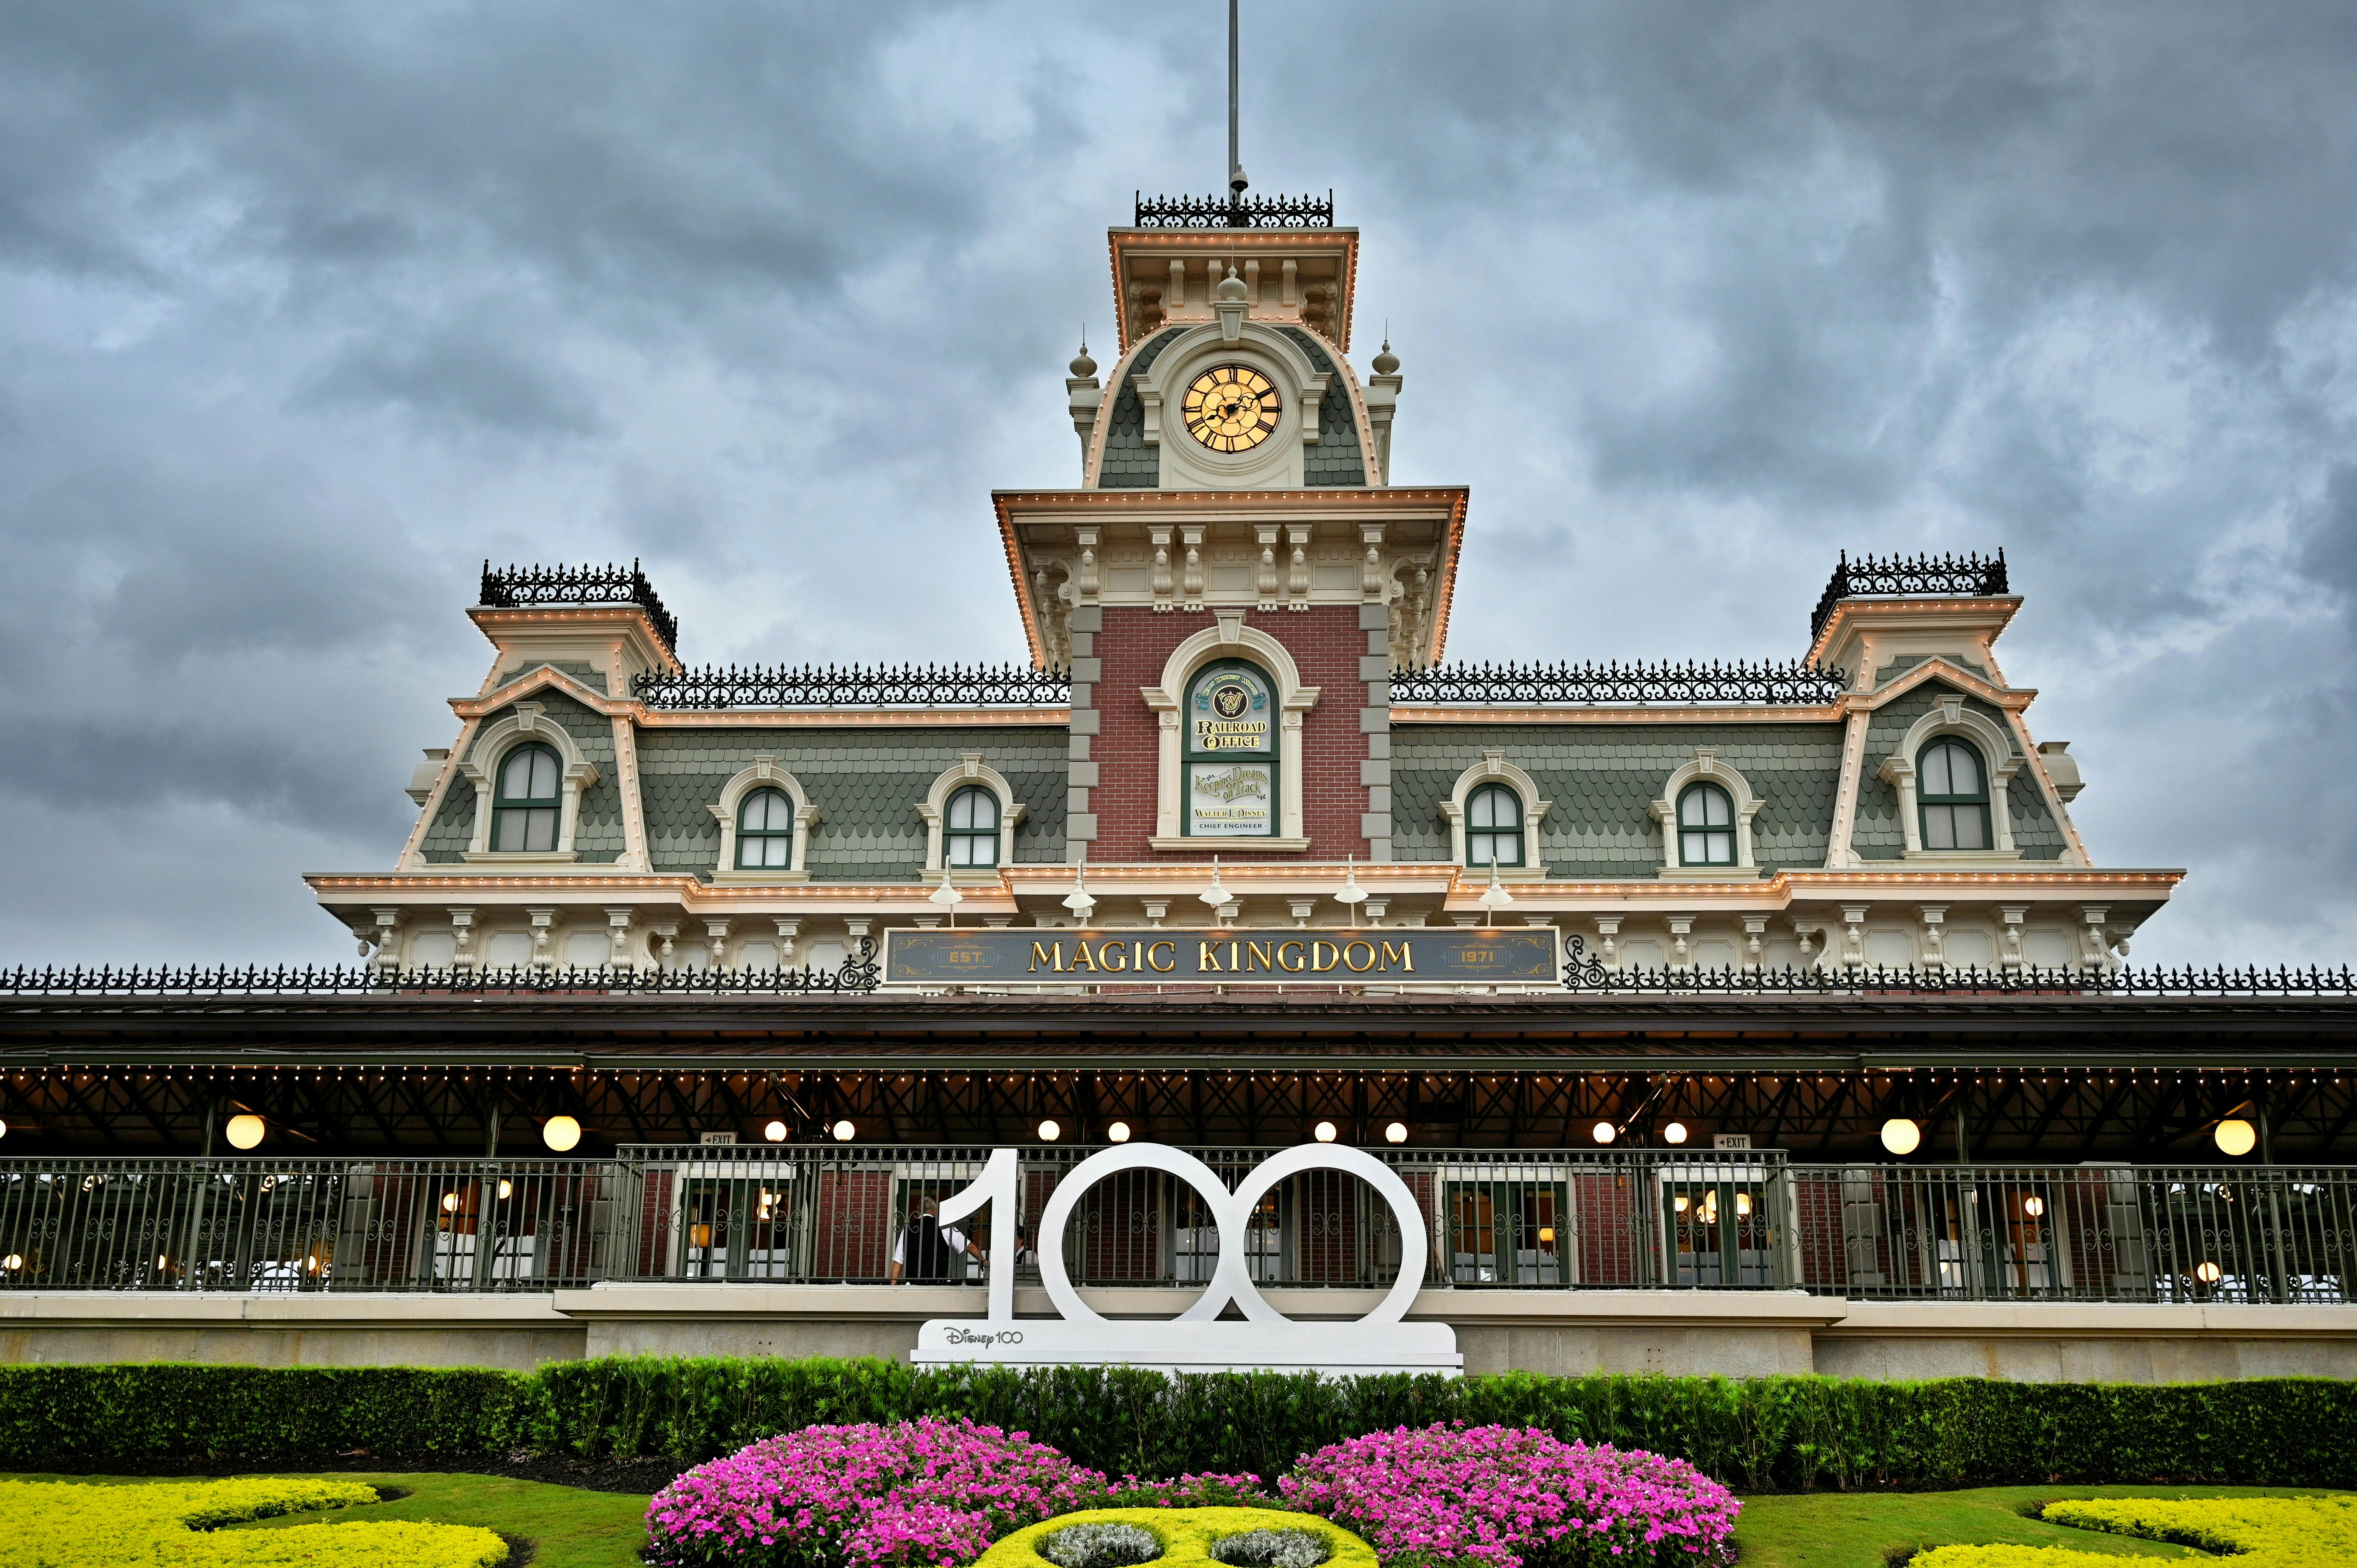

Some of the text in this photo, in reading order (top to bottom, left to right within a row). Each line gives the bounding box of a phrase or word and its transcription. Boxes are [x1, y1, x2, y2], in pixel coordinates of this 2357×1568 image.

[1202, 675, 1258, 696] WALT DISNEY WORLD
[1195, 720, 1267, 735] RAILROAD
[1202, 735, 1260, 750] OFFICE
[1195, 766, 1268, 797] Keeping Dreams
[1223, 781, 1262, 799] on Track
[1194, 808, 1228, 818] WALTER
[1237, 808, 1267, 818] DISNEY
[949, 940, 1494, 972] EST. MAGIC KINGDOM 1971
[713, 1135, 732, 1144] EXIT
[1727, 1137, 1746, 1148] EXIT
[939, 1142, 1428, 1321] 100
[996, 1331, 1023, 1344] 100
